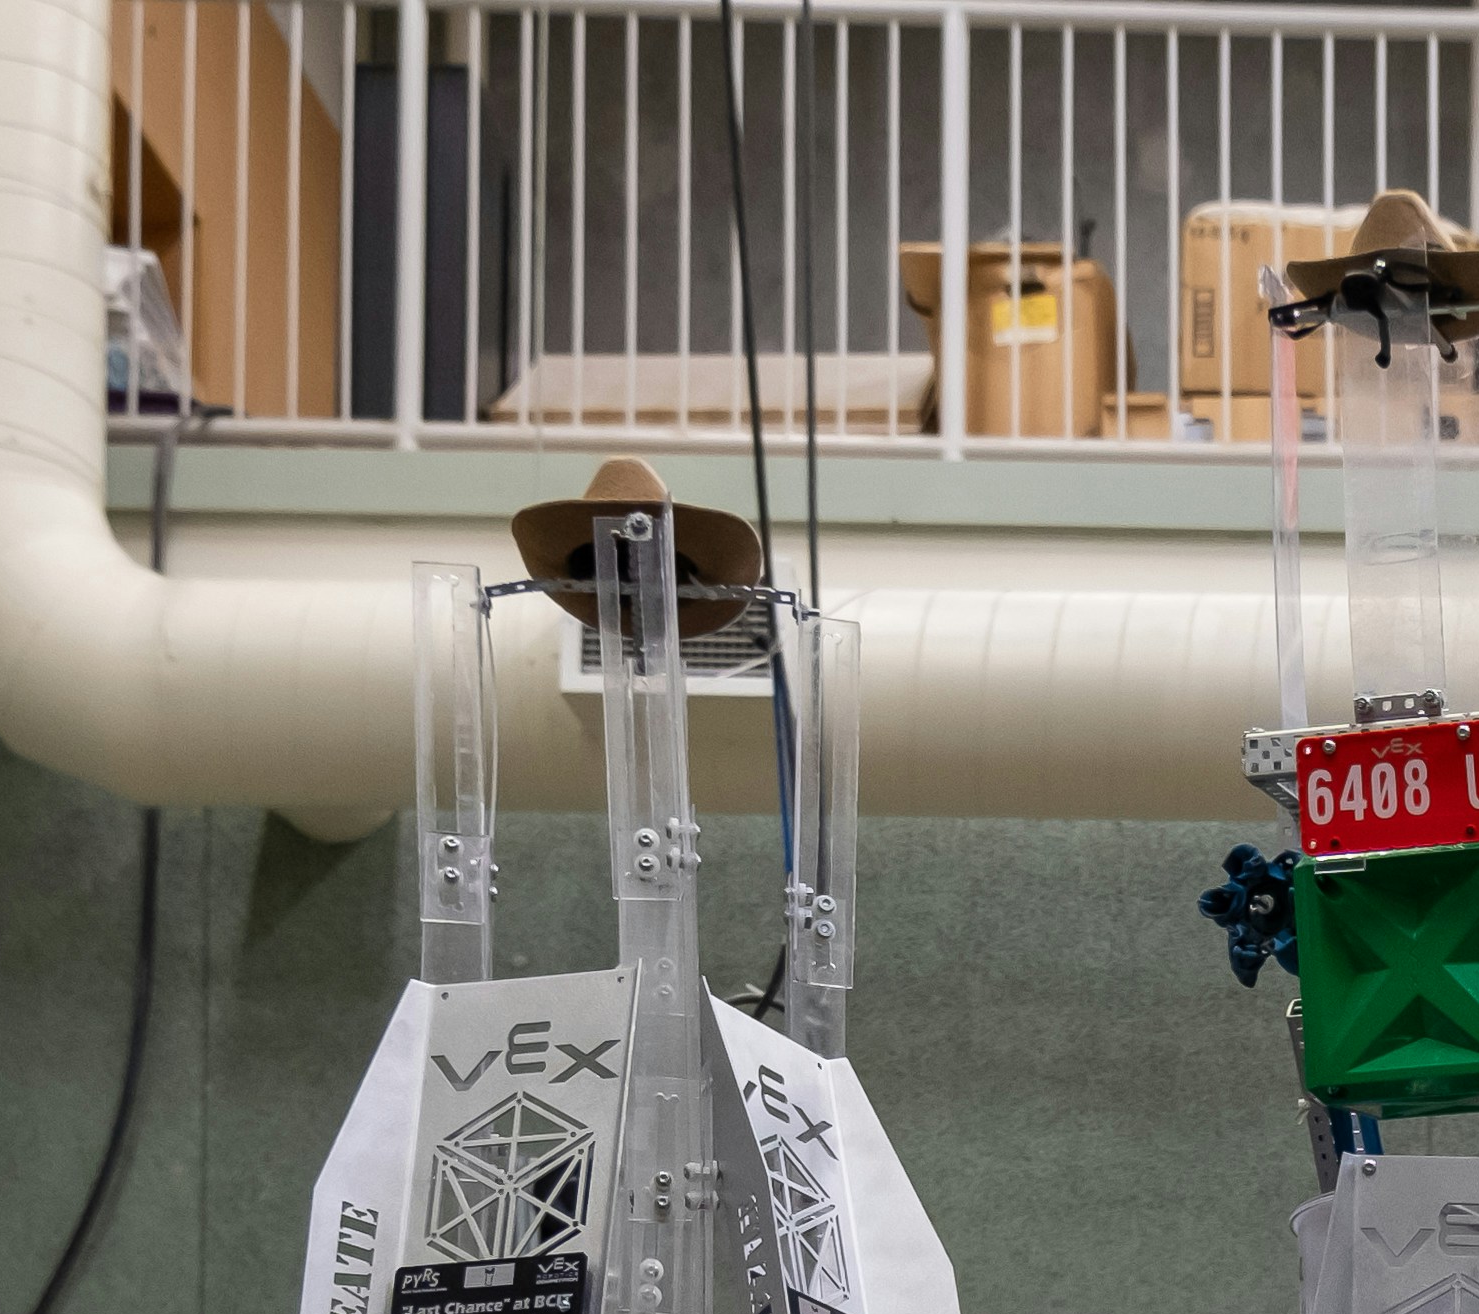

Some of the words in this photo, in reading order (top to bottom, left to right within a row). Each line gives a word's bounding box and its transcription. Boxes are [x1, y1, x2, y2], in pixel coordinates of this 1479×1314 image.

[1371, 737, 1424, 759] VEX
[1307, 758, 1431, 826] 6408
[431, 1021, 621, 1092] VEX
[538, 1257, 580, 1273] VEX
[402, 1268, 440, 1290] PYRS
[513, 1297, 530, 1311] at
